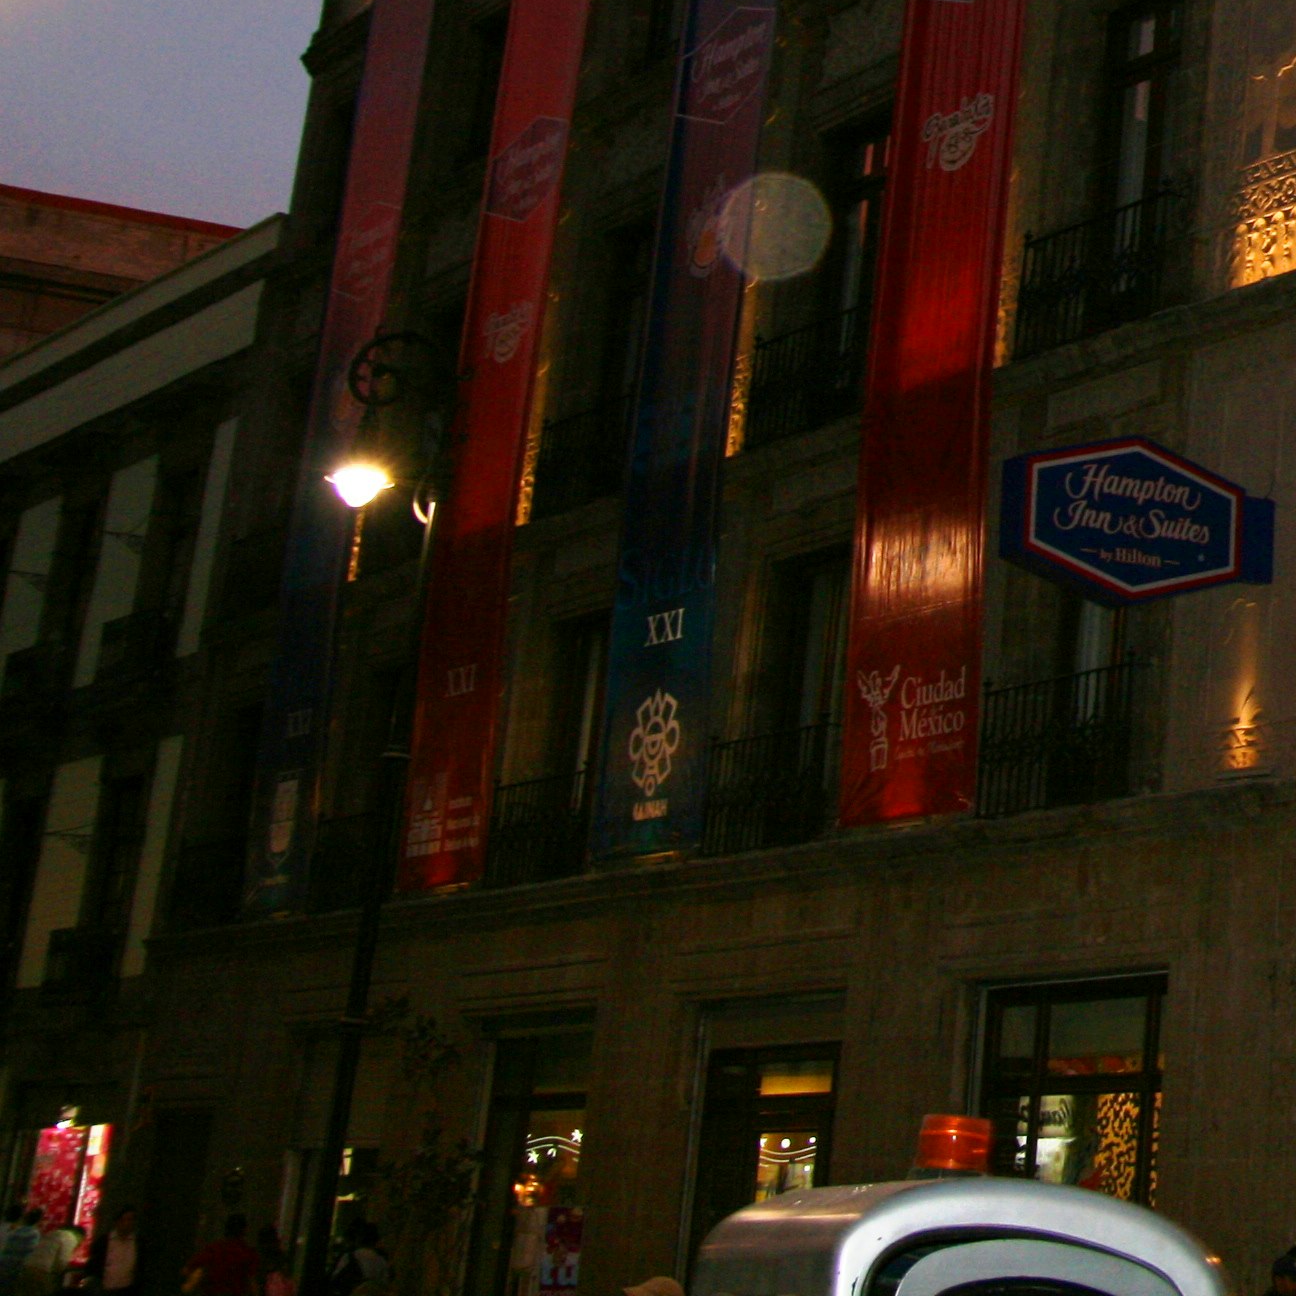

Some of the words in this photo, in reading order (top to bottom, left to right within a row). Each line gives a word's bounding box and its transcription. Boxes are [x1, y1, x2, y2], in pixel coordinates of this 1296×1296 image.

[1065, 463, 1201, 512] Hampton
[1053, 500, 1123, 535] Inn
[1122, 514, 1141, 540] &
[1138, 508, 1211, 545] Suites
[1112, 547, 1162, 569] Hilton
[643, 607, 686, 647] XXI
[444, 663, 478, 698] XXI
[900, 664, 966, 710] Ciudad
[898, 704, 967, 741] México
